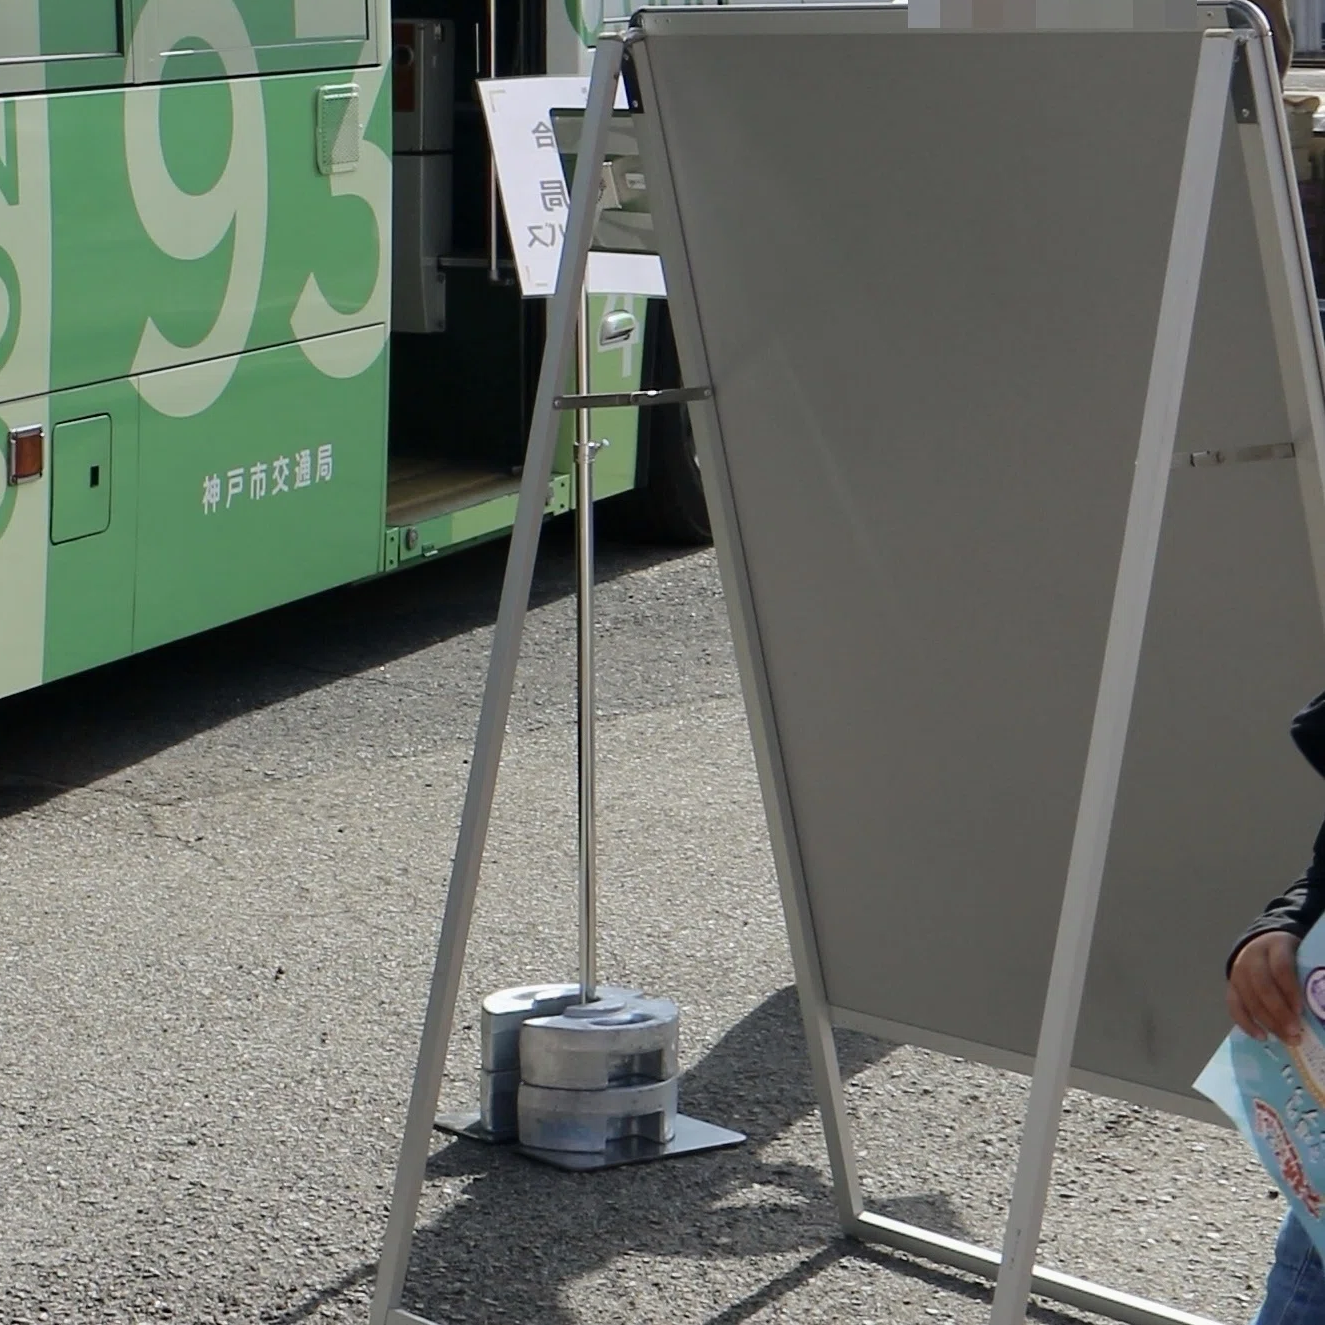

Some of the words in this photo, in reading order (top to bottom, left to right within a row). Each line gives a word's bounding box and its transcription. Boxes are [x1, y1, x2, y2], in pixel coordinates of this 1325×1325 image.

[199, 445, 335, 516] 神戸市交通局
